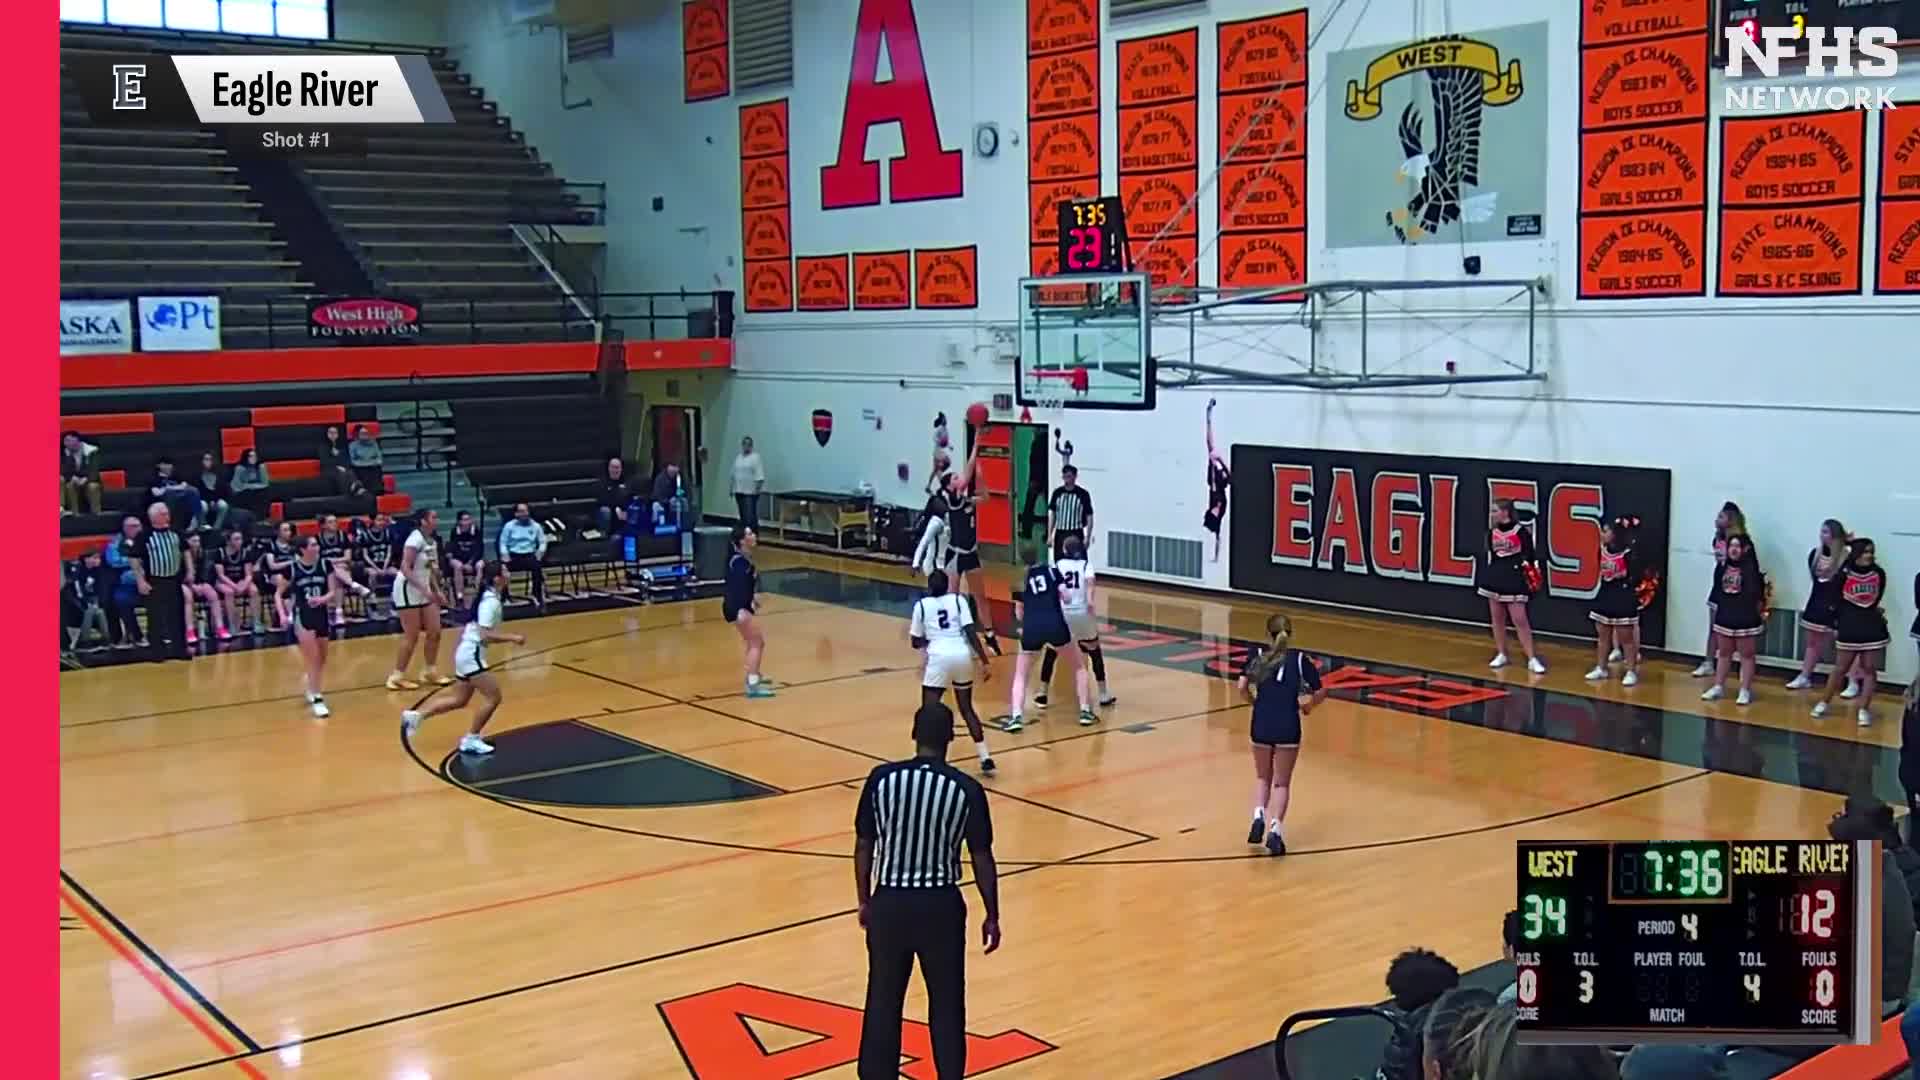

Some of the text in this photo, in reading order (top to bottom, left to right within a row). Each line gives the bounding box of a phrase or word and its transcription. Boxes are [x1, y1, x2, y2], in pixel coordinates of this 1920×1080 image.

[1604, 16, 1684, 36] VOLLEYBALL
[1397, 45, 1462, 69] WEST
[1640, 47, 1698, 94] CHAMPIONS
[820, 0, 964, 210] A
[1635, 100, 1684, 118] SOCCER
[1587, 146, 1619, 190] REGION
[1639, 133, 1697, 183] CHAMPIONS
[1730, 135, 1766, 181] REGION
[1788, 122, 1854, 176] CHAMPIONS
[1636, 187, 1683, 203] SOCCER
[1745, 180, 1836, 199] BOYS SOCCER
[1068, 228, 1102, 269] 23
[1586, 230, 1619, 273] REGION
[1638, 220, 1696, 270] CHAMPIONS
[1731, 212, 1849, 264] STATE CHAMPIONS
[1635, 274, 1682, 290] SOCCER
[1735, 273, 1772, 288] GIRLS
[326, 304, 404, 326] West High
[312, 325, 420, 336] FOUNDATION
[1029, 575, 1047, 594] 13
[1063, 571, 1080, 589] 21
[937, 609, 950, 629] 2
[1528, 850, 1578, 877] WEST
[1644, 850, 1723, 895] 7:36
[1524, 894, 1566, 939] 34
[1801, 889, 1835, 938] 12
[1638, 913, 1698, 940] PERIOD 4
[1634, 952, 1706, 966] PLAYER FOUL
[1802, 952, 1837, 966] FOULS
[1519, 969, 1537, 1003] 0
[1578, 970, 1594, 1003] 3
[1743, 974, 1761, 1001] 4
[1815, 969, 1834, 1006] 0
[1649, 1008, 1685, 1023] MATCH
[1801, 1010, 1837, 1024] SCORE
